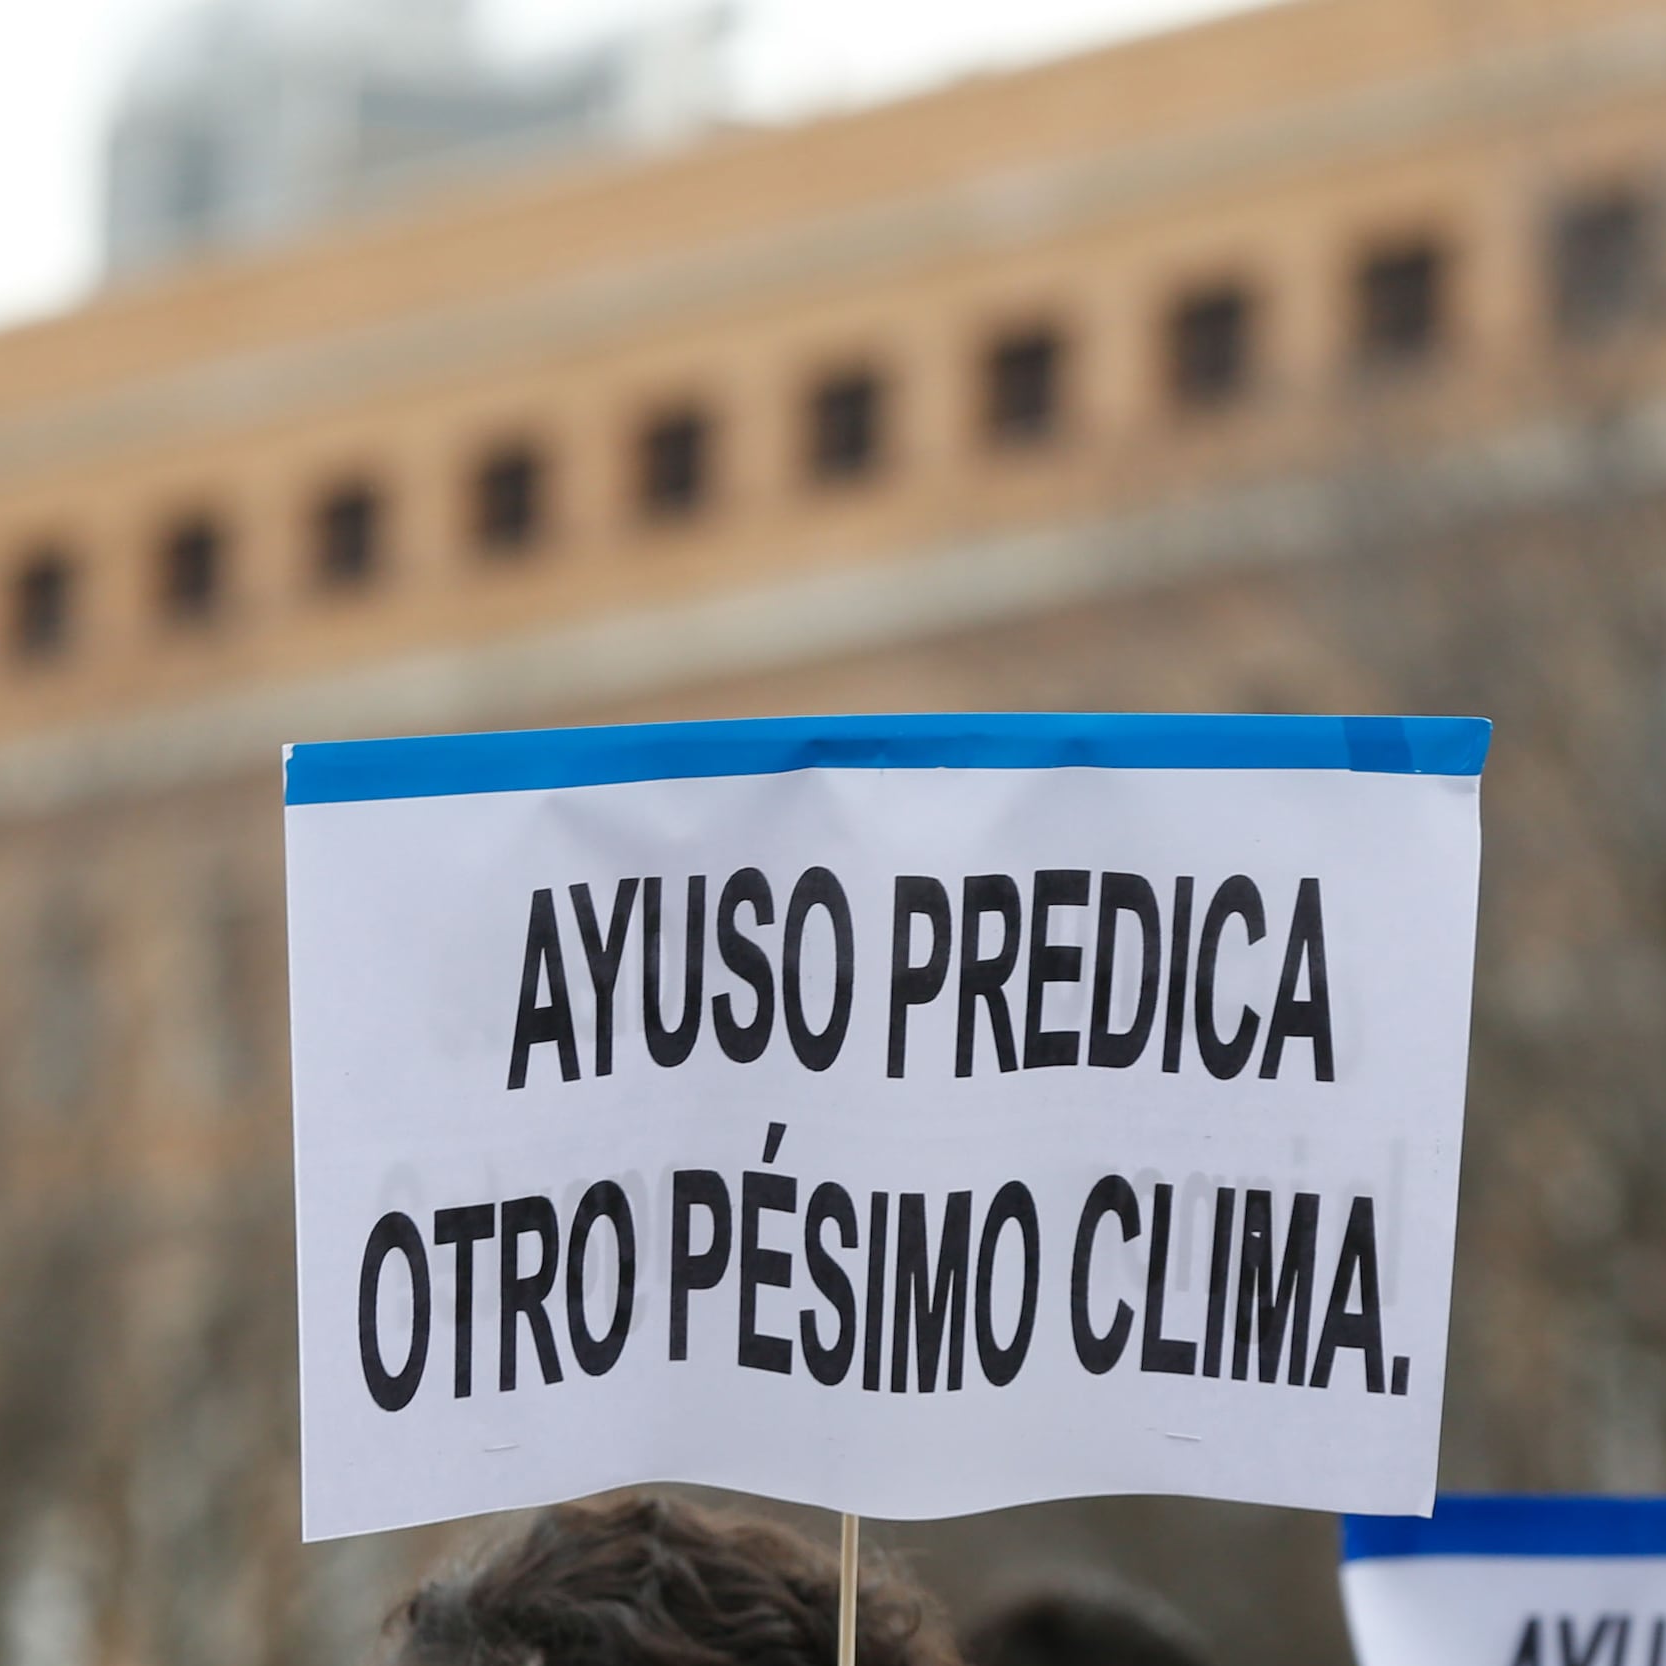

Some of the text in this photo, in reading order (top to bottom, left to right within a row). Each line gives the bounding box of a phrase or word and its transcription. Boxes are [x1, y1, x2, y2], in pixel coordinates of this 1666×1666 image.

[506, 865, 1336, 1091] AYUSO PREDICA
[357, 1121, 1411, 1413] OTRO PÉSIMO CLIMA.
